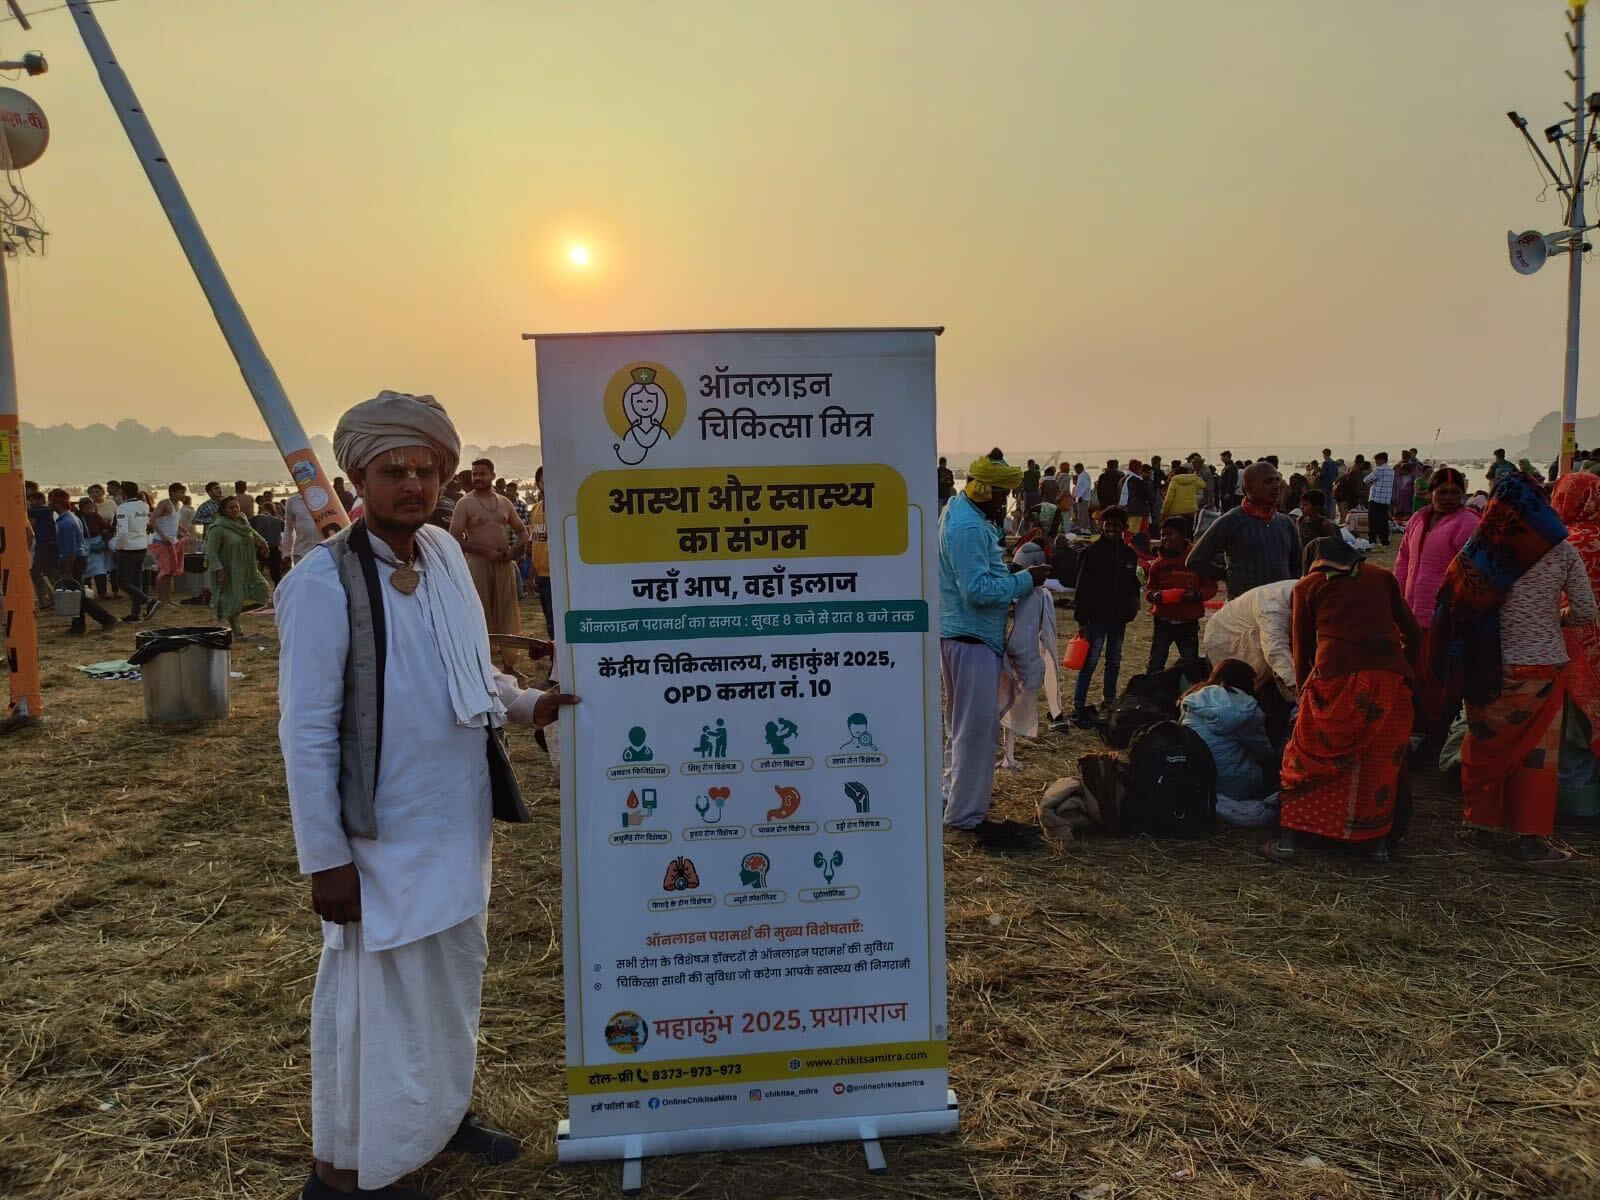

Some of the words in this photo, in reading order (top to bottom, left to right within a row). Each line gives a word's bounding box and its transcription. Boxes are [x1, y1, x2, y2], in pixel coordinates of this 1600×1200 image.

[699, 366, 833, 402] ऑनलाइन
[698, 406, 812, 441] चिकित्सा
[820, 406, 874, 438] मित्र
[608, 486, 700, 515] आस्था
[708, 474, 761, 513] और
[767, 481, 874, 511] स्वास्थ्य
[677, 528, 719, 554] का
[725, 517, 808, 552] संगम
[632, 568, 680, 601] जहाँ
[684, 577, 739, 601] आप,
[744, 564, 786, 599] वहाँ
[789, 572, 858, 598] इलाज
[579, 617, 639, 634] ऑनलाइन
[642, 615, 687, 631] परामर्श
[688, 616, 705, 629] का
[709, 616, 741, 629] समय
[751, 615, 780, 630] सुबह
[782, 614, 791, 625] 8
[795, 611, 816, 625] बजे
[818, 611, 829, 624] से
[831, 612, 853, 624] रात
[856, 611, 864, 623] 8
[868, 608, 889, 623] बजे
[892, 611, 915, 623] तक
[598, 655, 650, 679] केंद्रीय
[653, 652, 767, 676] चिकित्सालय,
[772, 648, 840, 674] महाकुंभ
[843, 650, 895, 668] 2025,
[664, 684, 711, 704] OPD
[715, 682, 775, 701] कमरा
[780, 677, 803, 699] नं.
[809, 680, 831, 697] 10
[645, 930, 706, 947] ऑनलाइन
[709, 927, 754, 942] परामर्श
[755, 925, 771, 938] की
[773, 926, 803, 942] मुख्य
[616, 956, 637, 969] सभी
[640, 957, 657, 969] रोग
[660, 956, 671, 967] के
[712, 950, 746, 963] डॉक्टरों
[748, 949, 758, 961] से
[761, 947, 809, 960] ऑनलाइन
[811, 944, 845, 957] परामर्श
[848, 943, 861, 955] की
[864, 940, 894, 956] सुविधा
[616, 975, 659, 988] चिकित्सा
[661, 973, 687, 986] साथी
[688, 971, 702, 983] की
[705, 969, 736, 986] सुविधा
[738, 968, 751, 980] जो
[753, 966, 782, 979] करेगा
[784, 964, 814, 977] आपके
[817, 964, 852, 975] स्वास्थ्य
[854, 960, 868, 972] की
[870, 957, 911, 971] निगरानी
[652, 1009, 734, 1044] महाकुंभ
[742, 1008, 807, 1034] 2025,
[809, 1002, 908, 1028] प्रयागराज
[806, 1051, 927, 1068] www.chikitsamitra.com
[588, 1070, 634, 1085] टोल-फ्री
[652, 1064, 742, 1081] 8373-973-973
[846, 1079, 925, 1093] @onlinechikitsamitra
[662, 1094, 738, 1106] OnlineChikitsaMitra
[765, 1087, 818, 1098] chikitsa_mitra
